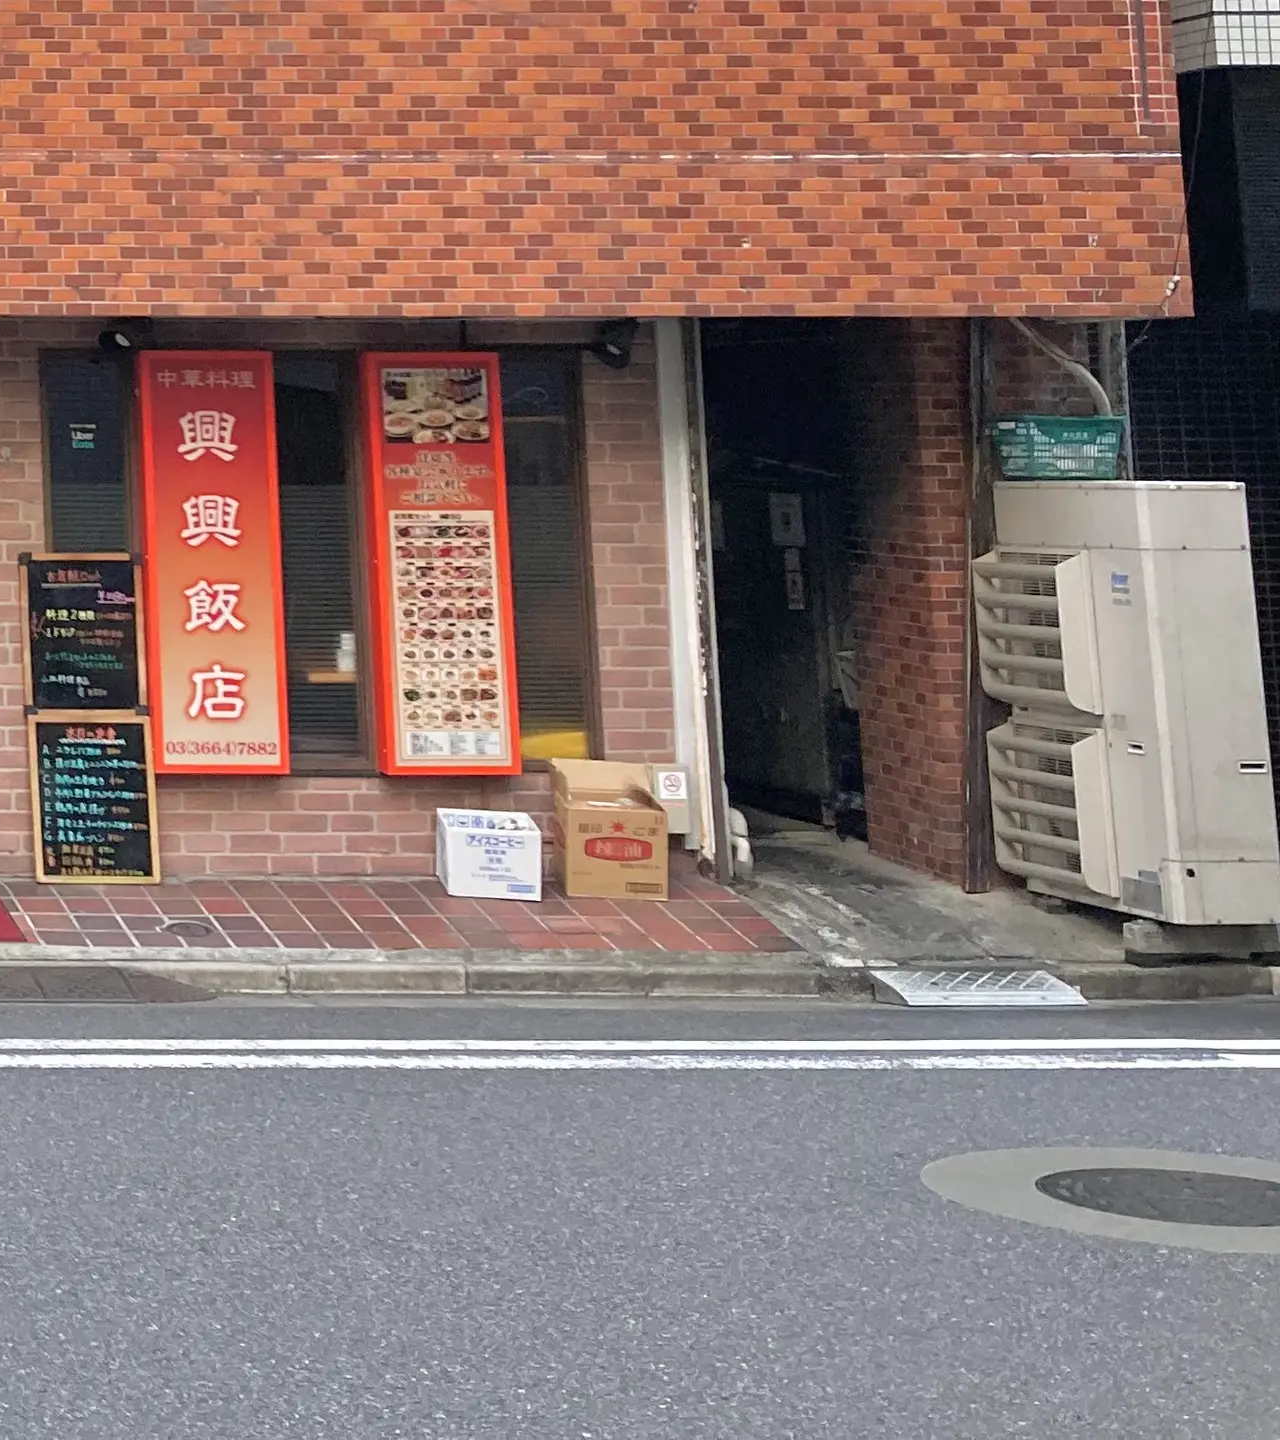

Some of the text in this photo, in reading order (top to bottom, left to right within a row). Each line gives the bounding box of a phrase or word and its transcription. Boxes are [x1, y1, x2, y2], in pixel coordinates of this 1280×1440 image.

[156, 369, 256, 389] 中華料理
[72, 431, 94, 441] Uber
[72, 440, 95, 449] Eats
[177, 410, 246, 719] 興興飯店
[166, 741, 277, 756] 03(3664)7882
[468, 835, 523, 848] アイスコーヒー
